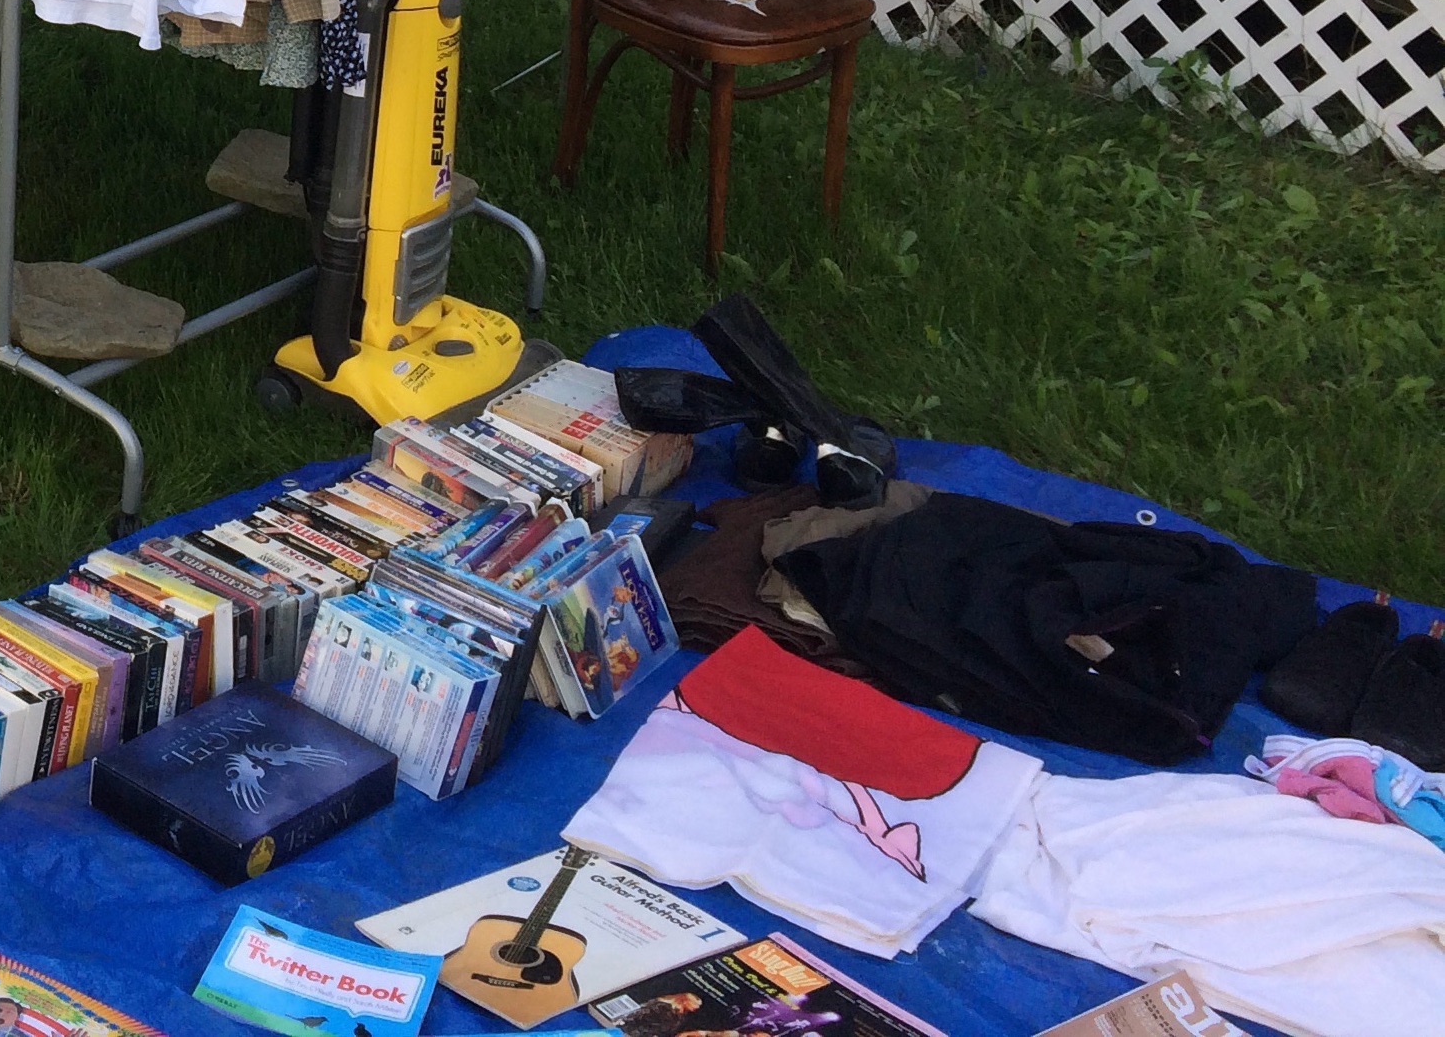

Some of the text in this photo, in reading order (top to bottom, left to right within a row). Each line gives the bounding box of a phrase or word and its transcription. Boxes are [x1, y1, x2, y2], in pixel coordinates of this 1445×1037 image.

[431, 66, 449, 166] EUREKA
[277, 543, 325, 573] SMOKE
[289, 520, 363, 566] BULWORTH
[180, 554, 263, 601] EDUCATING RITA
[620, 568, 660, 646] LION KING
[146, 687, 155, 712] TAI
[40, 698, 61, 767] EYEWITNESS
[56, 731, 68, 756] LIVING
[62, 704, 74, 732] PLANET
[162, 709, 265, 766] ANGEL
[590, 874, 636, 901] Guitar
[634, 898, 696, 931] Method
[612, 873, 706, 926] Alfred's Basic
[249, 934, 270, 948] The
[695, 926, 727, 943] 1
[749, 944, 784, 976] Sing
[247, 943, 334, 985] Twitter
[337, 975, 408, 1005] Book
